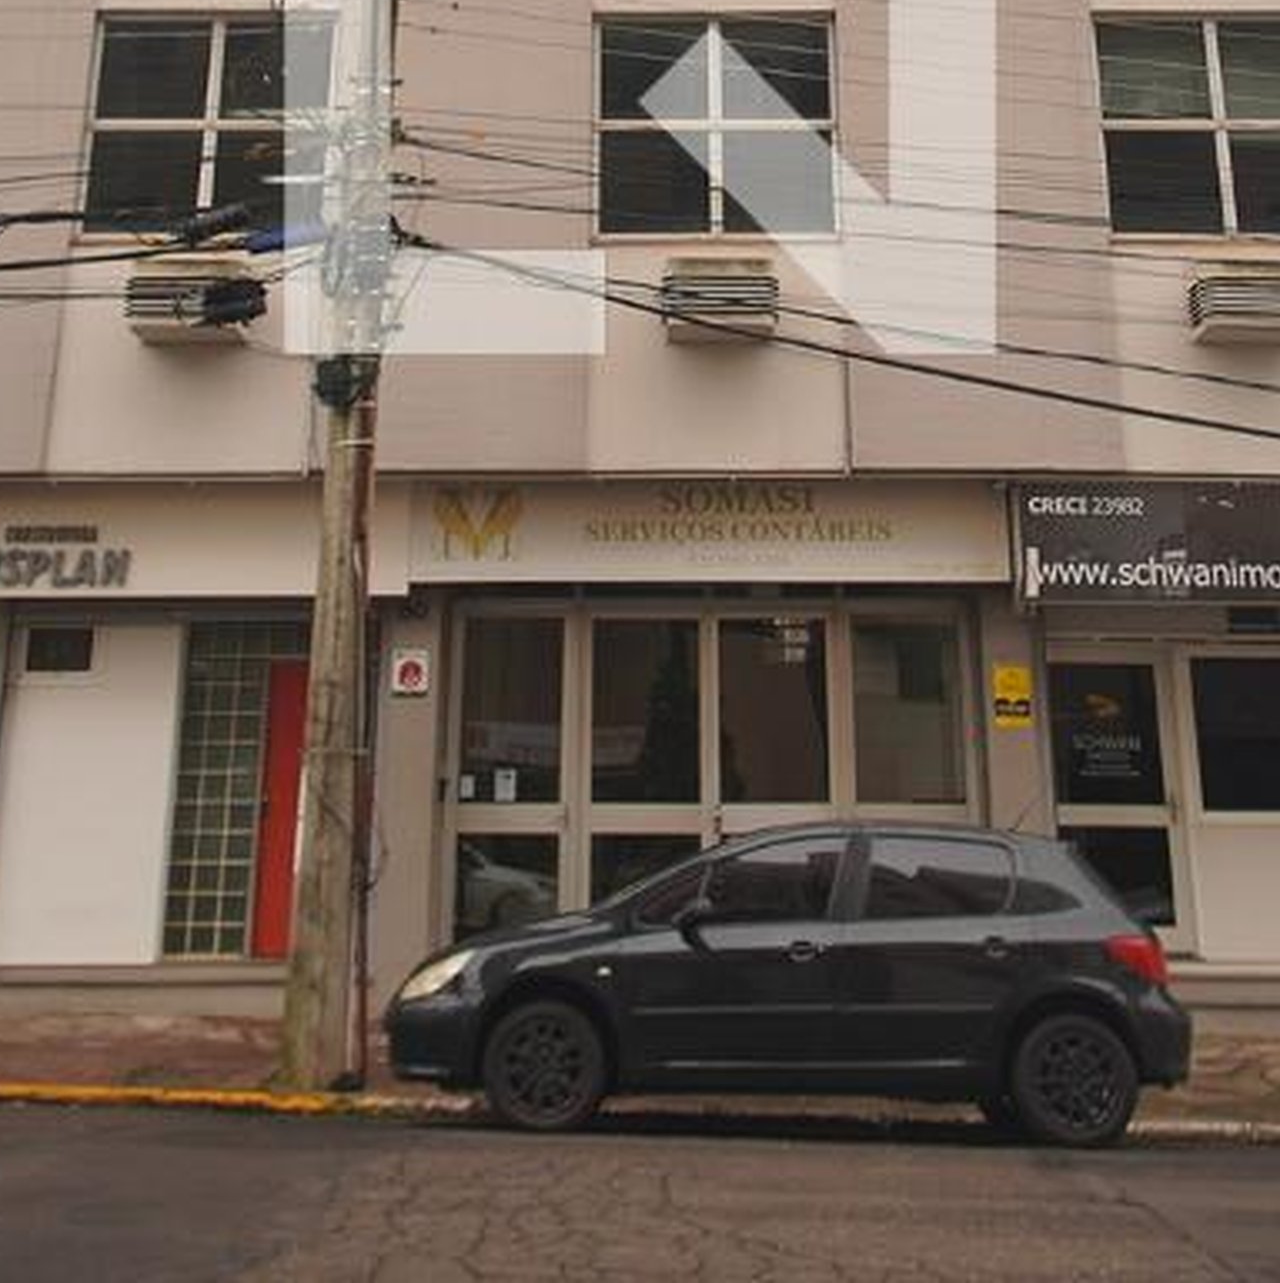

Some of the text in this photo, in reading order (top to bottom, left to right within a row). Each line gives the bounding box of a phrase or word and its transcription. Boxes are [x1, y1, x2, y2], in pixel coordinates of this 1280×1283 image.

[660, 479, 815, 514] SOMASI
[1027, 496, 1144, 517] CRECI 23982
[585, 518, 724, 545] SERVIÇOS
